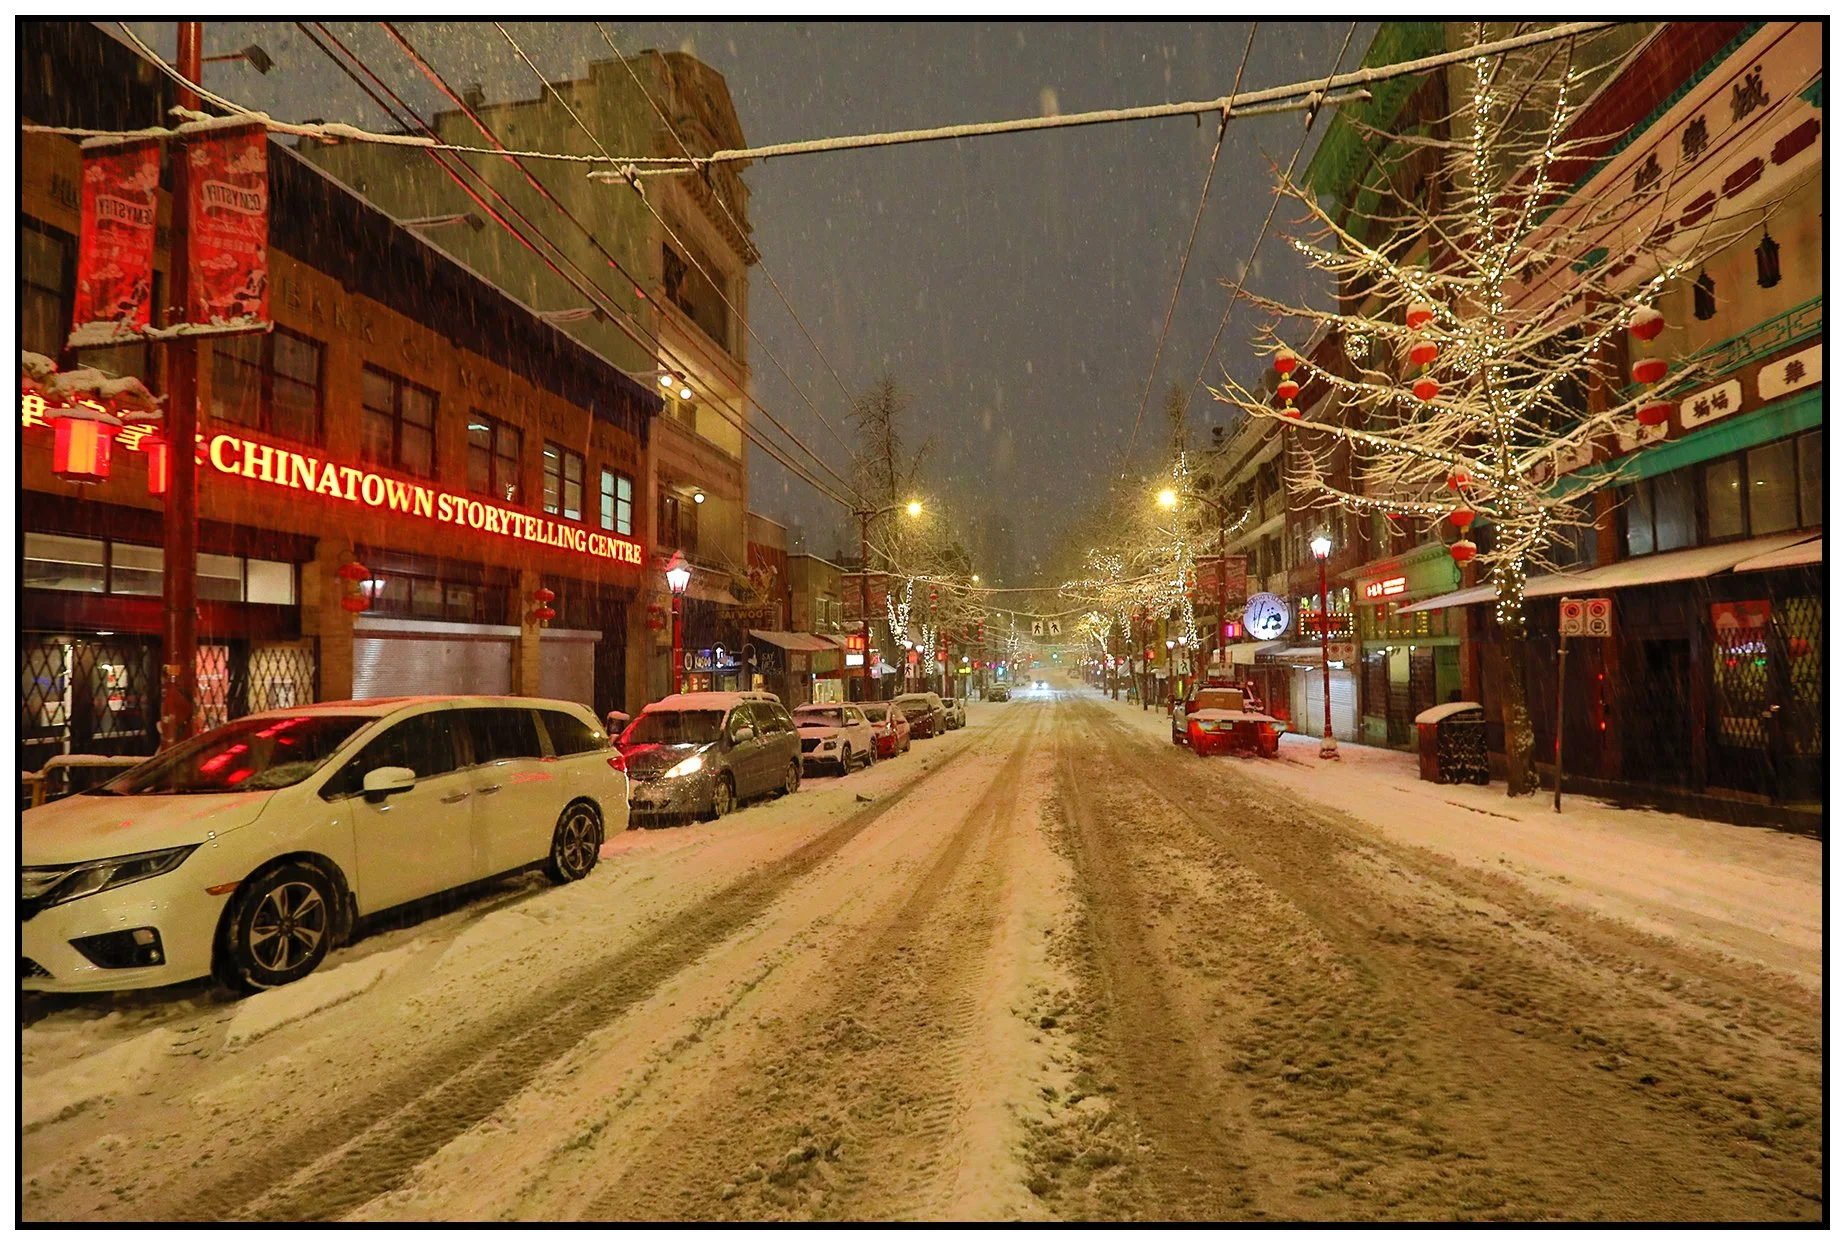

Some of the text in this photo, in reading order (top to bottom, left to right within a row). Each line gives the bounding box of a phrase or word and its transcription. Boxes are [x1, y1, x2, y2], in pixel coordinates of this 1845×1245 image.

[283, 278, 375, 345] BANK
[401, 337, 434, 371] OF
[209, 434, 642, 565] CHINATOWN STORYTELLING CENTRE
[737, 609, 763, 619] WOO
